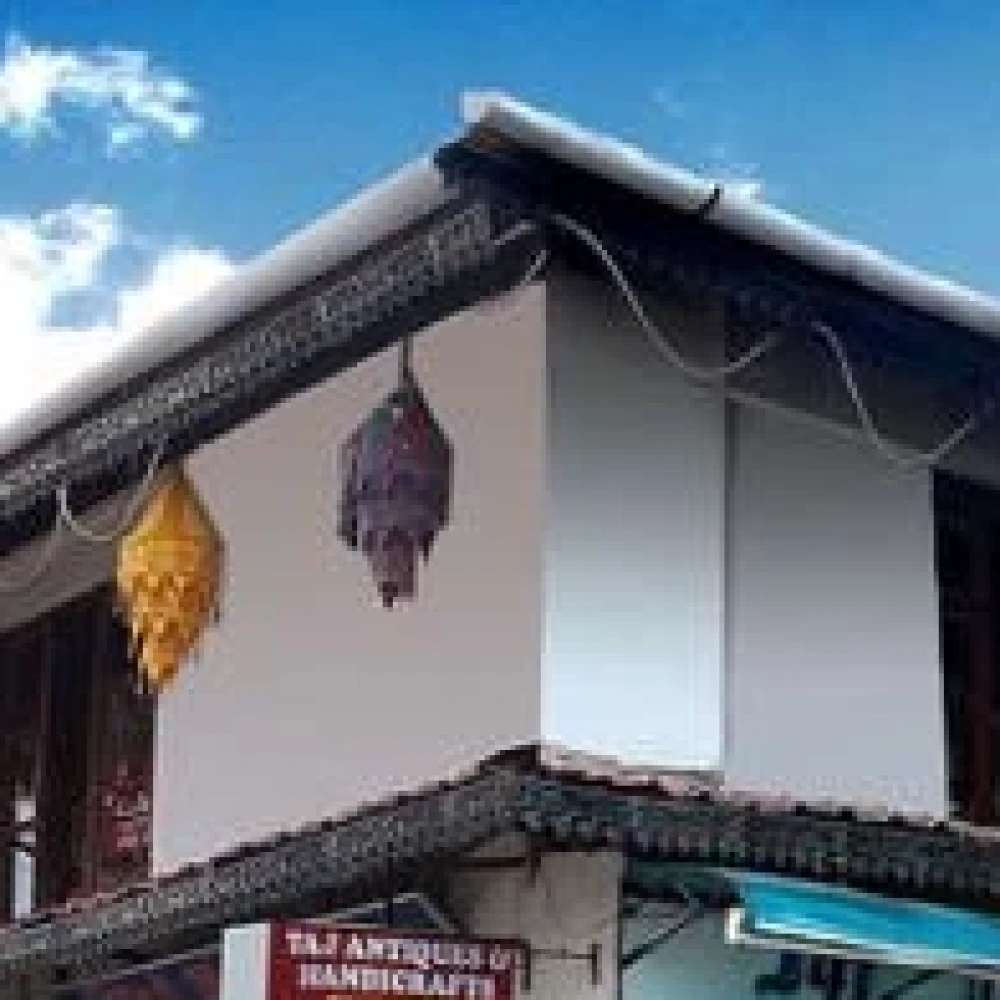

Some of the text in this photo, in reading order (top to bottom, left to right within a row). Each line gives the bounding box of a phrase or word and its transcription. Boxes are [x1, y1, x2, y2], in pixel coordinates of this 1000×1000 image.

[285, 930, 340, 957] TAJ
[345, 934, 484, 971] ANTIQUES
[299, 963, 496, 1000] HANDICRAFTS
